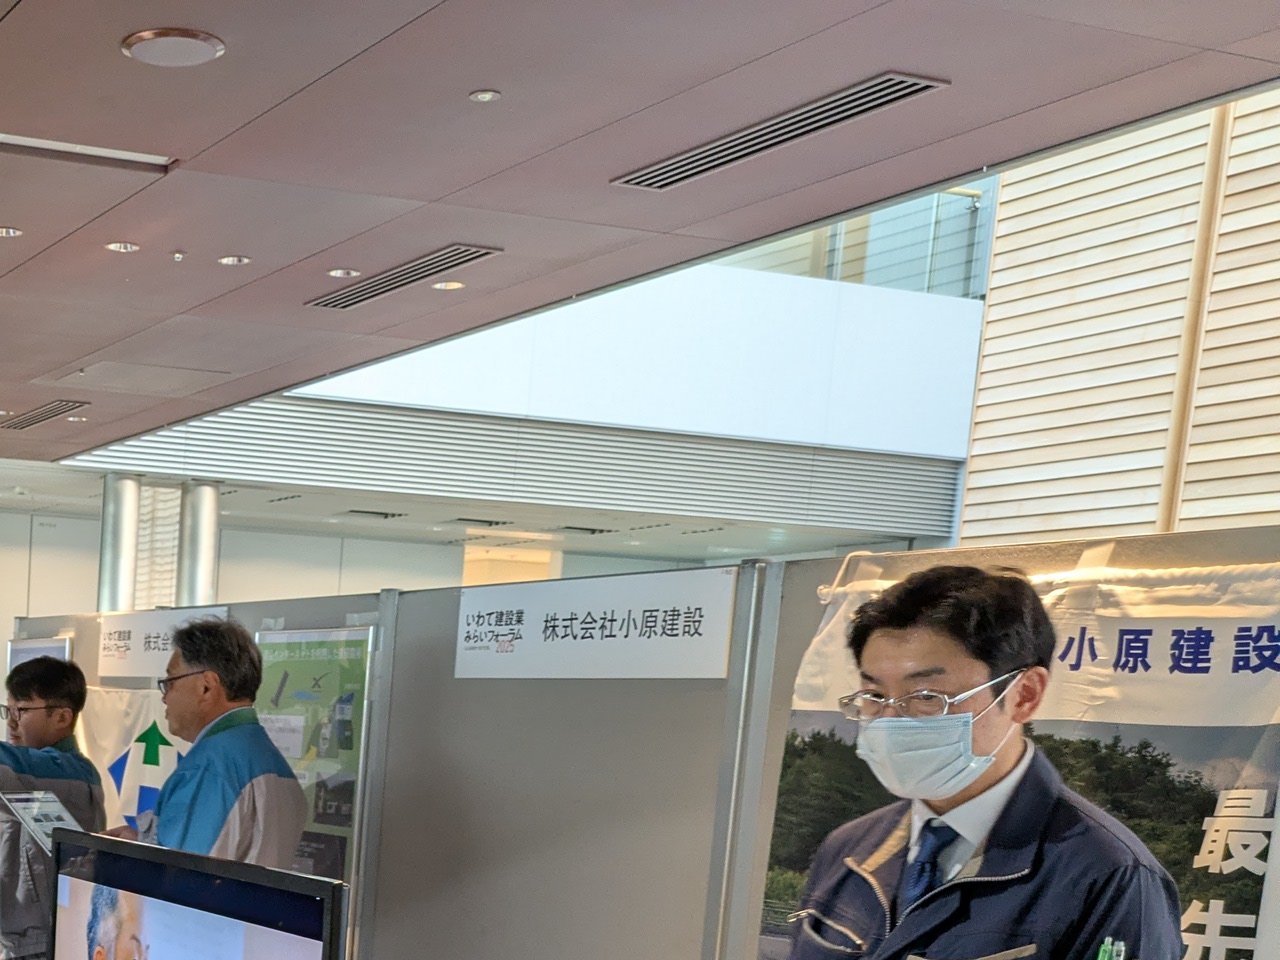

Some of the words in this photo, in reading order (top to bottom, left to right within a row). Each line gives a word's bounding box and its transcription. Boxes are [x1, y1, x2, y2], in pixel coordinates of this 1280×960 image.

[466, 608, 524, 627] いわて建設業
[542, 606, 704, 642] 株式会社小原建設
[144, 632, 173, 652] 株式会
[464, 628, 523, 643] みらいフォーラム
[1058, 624, 1280, 674] 小原建設
